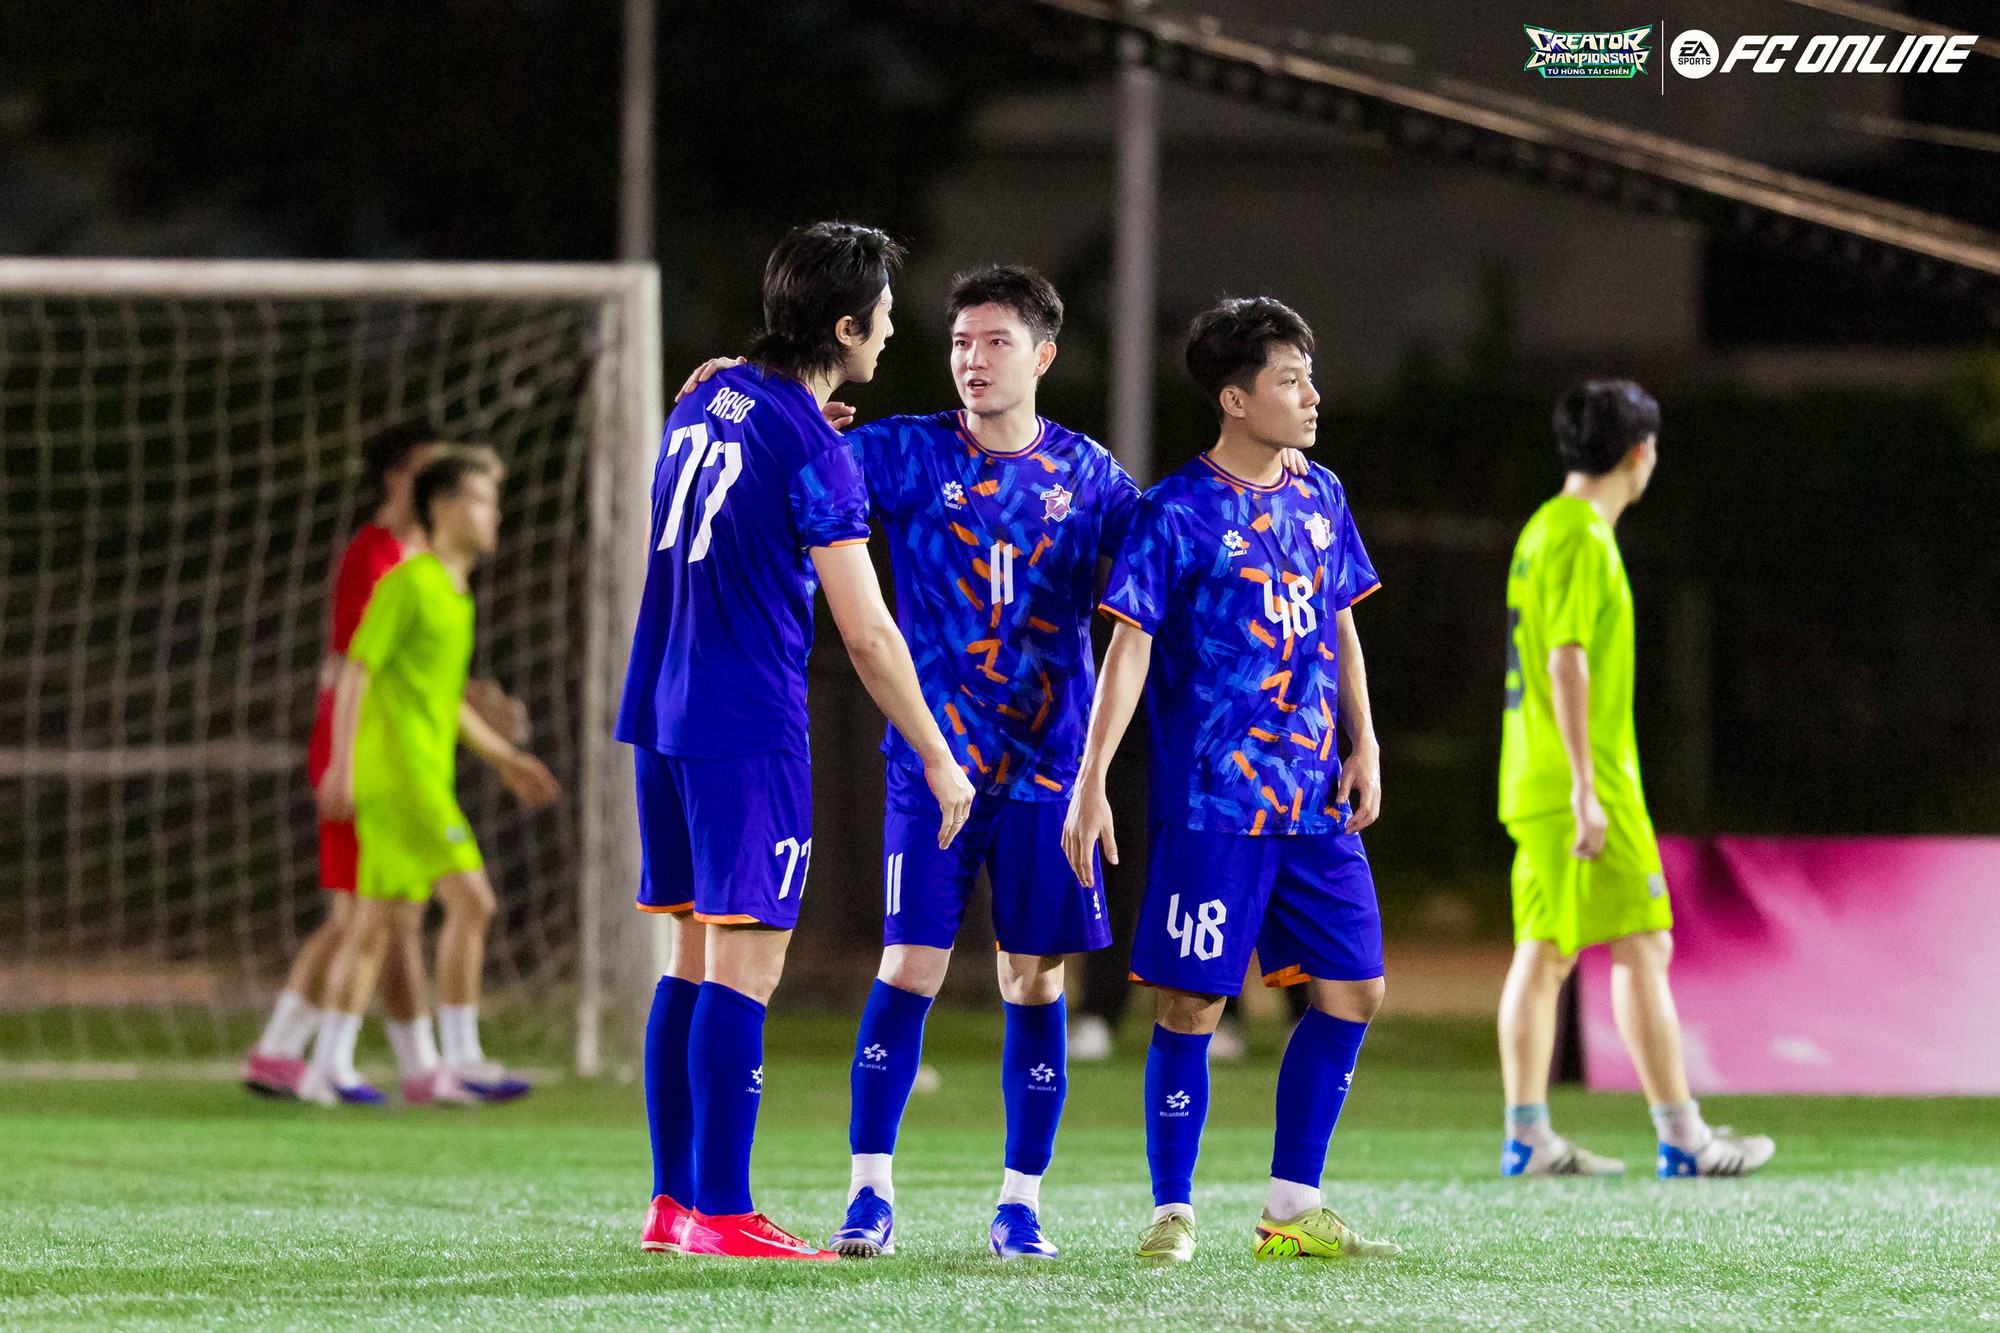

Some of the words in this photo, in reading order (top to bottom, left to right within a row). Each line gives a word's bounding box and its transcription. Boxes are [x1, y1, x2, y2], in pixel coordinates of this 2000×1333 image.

[706, 387, 756, 424] RAYO
[657, 422, 743, 563] 77
[990, 543, 1014, 606] 11
[1263, 575, 1317, 640] 48
[775, 837, 812, 900] 77
[887, 852, 904, 917] 11
[1166, 893, 1227, 961] 48
